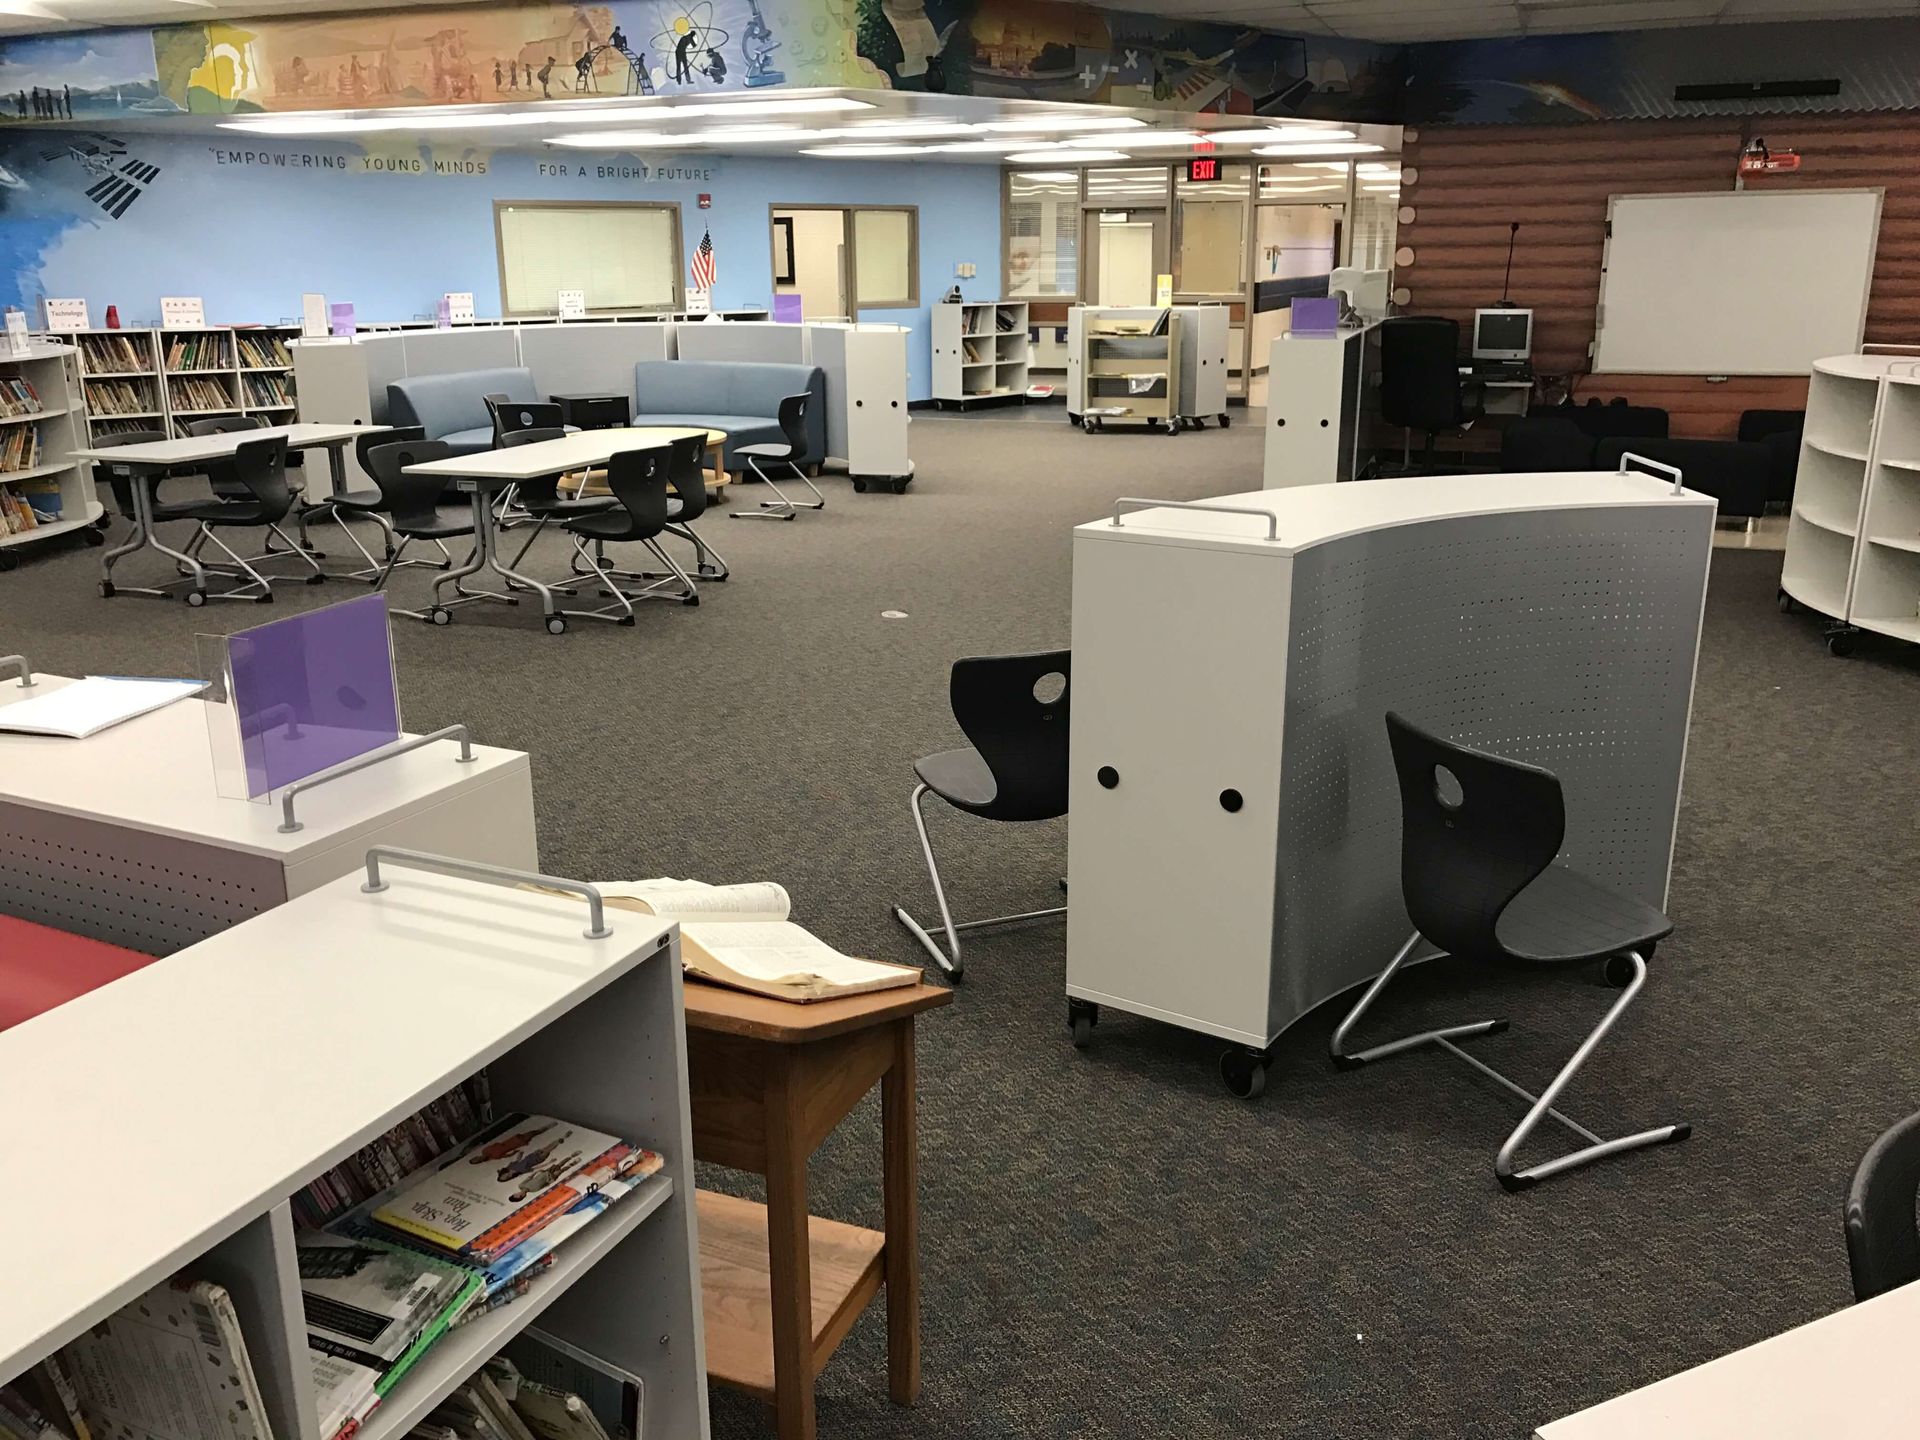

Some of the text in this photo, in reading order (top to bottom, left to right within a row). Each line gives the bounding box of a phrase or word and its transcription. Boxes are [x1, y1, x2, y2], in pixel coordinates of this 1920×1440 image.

[362, 158, 421, 172] YOUNG
[434, 159, 487, 174] MINDS
[539, 164, 567, 177] FOR
[578, 166, 587, 177] A
[597, 166, 649, 179] BRIGHT
[1192, 160, 1216, 179] EXIT
[443, 1196, 471, 1213] Run
